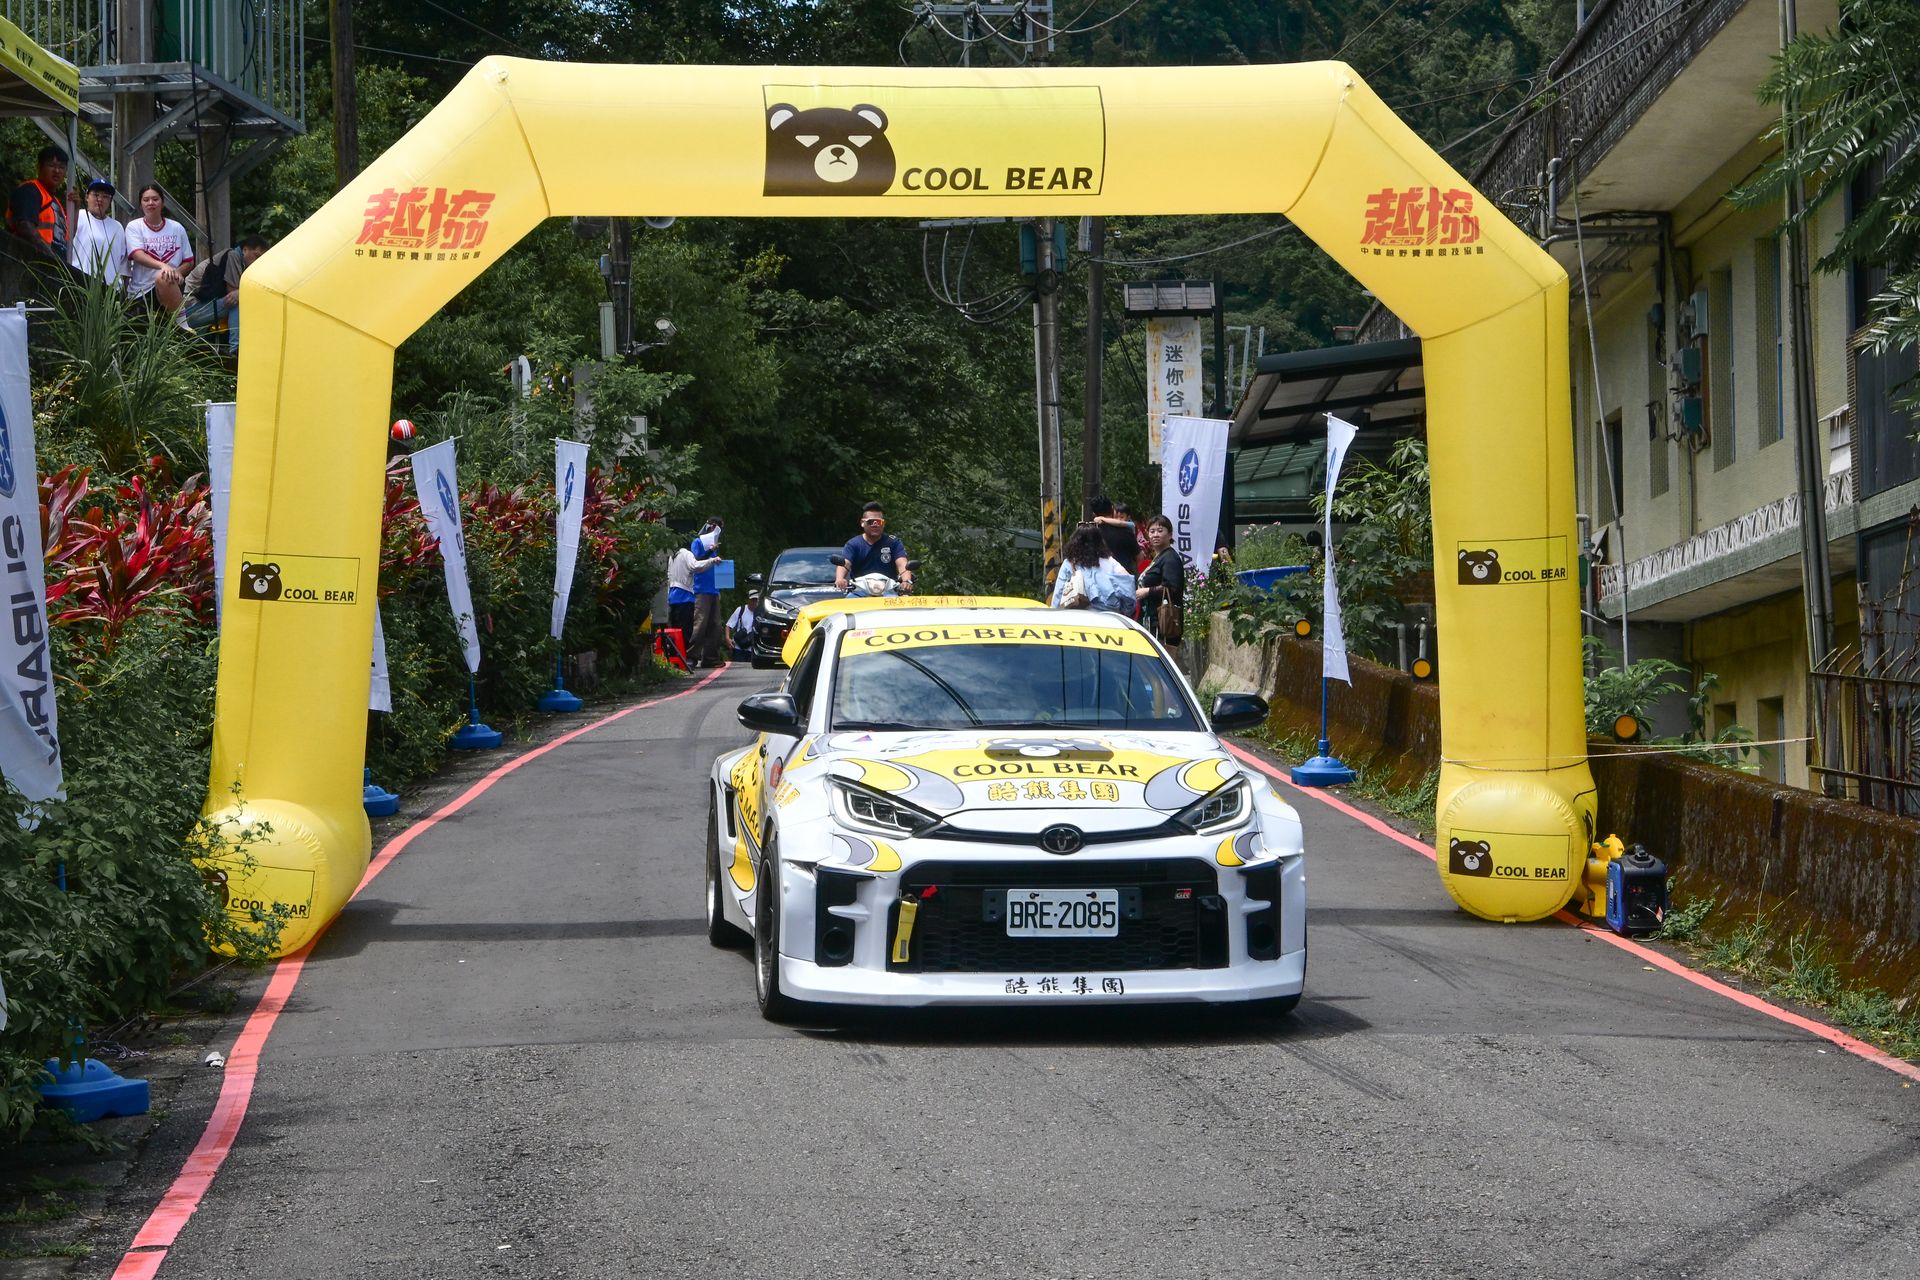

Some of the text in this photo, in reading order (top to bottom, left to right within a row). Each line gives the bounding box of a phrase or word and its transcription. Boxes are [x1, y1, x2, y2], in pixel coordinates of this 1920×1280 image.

[902, 167, 1093, 191] COOL BEAR
[355, 187, 496, 249] 越協
[1360, 186, 1480, 245] 越協
[1165, 345, 1185, 416] 迷你谷
[1504, 567, 1566, 581] COOL BEAR
[284, 588, 354, 601] COOL BEAR
[864, 628, 1123, 647] COOL-BEAR.TW
[953, 763, 1140, 777] COOL BEAR
[988, 780, 1119, 802] 酷熊集團
[1495, 866, 1566, 878] COOL BEAR
[231, 897, 267, 912] COOL
[1005, 976, 1124, 995] 酷熊集團
